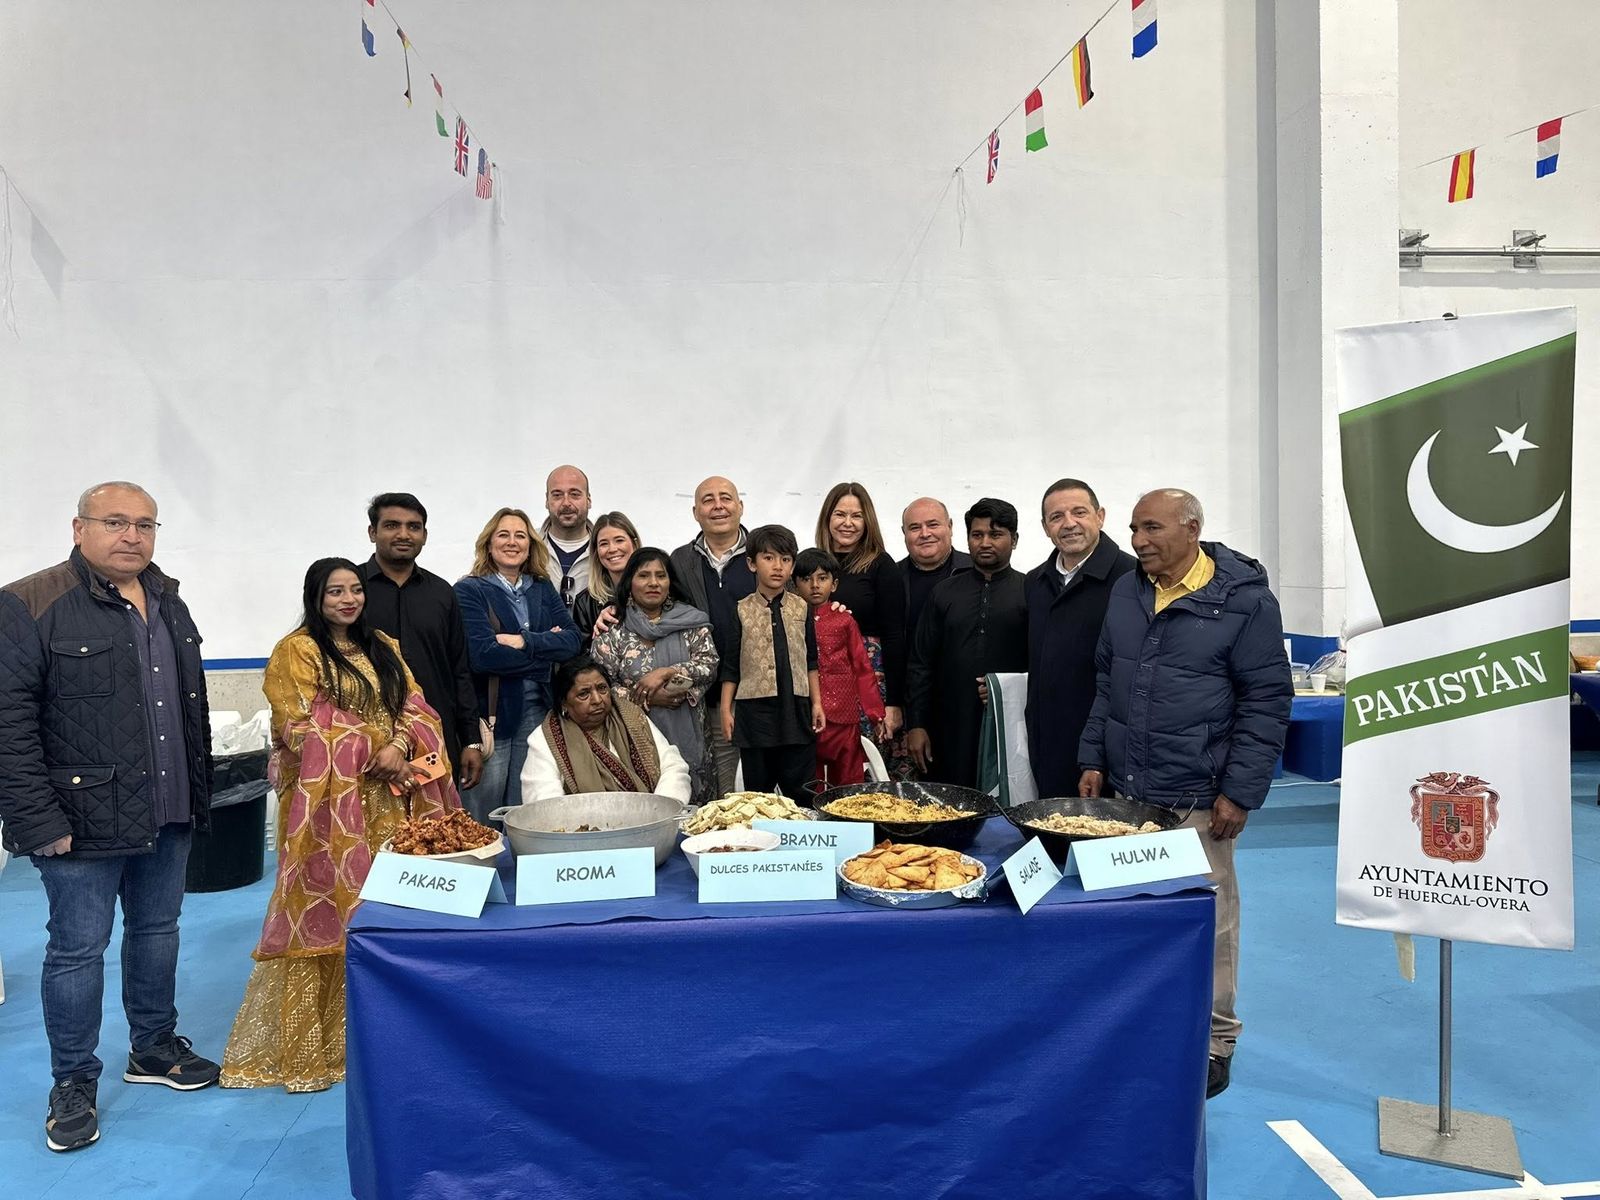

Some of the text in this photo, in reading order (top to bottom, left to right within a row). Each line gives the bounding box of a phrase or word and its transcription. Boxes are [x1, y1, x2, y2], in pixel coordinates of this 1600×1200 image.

[1351, 651, 1548, 727] PAKISTÁN
[780, 833, 838, 847] BRAYNI
[1111, 846, 1169, 866] HULWA
[556, 865, 616, 883] KROMA
[710, 860, 823, 874] DULCES PAKISTANÍES
[1019, 856, 1042, 884] SALADE
[398, 871, 457, 892] PAKARS
[1358, 864, 1549, 896] AYUNTAMIENTO
[1373, 886, 1531, 912] DE HUERCAL-OVERA
